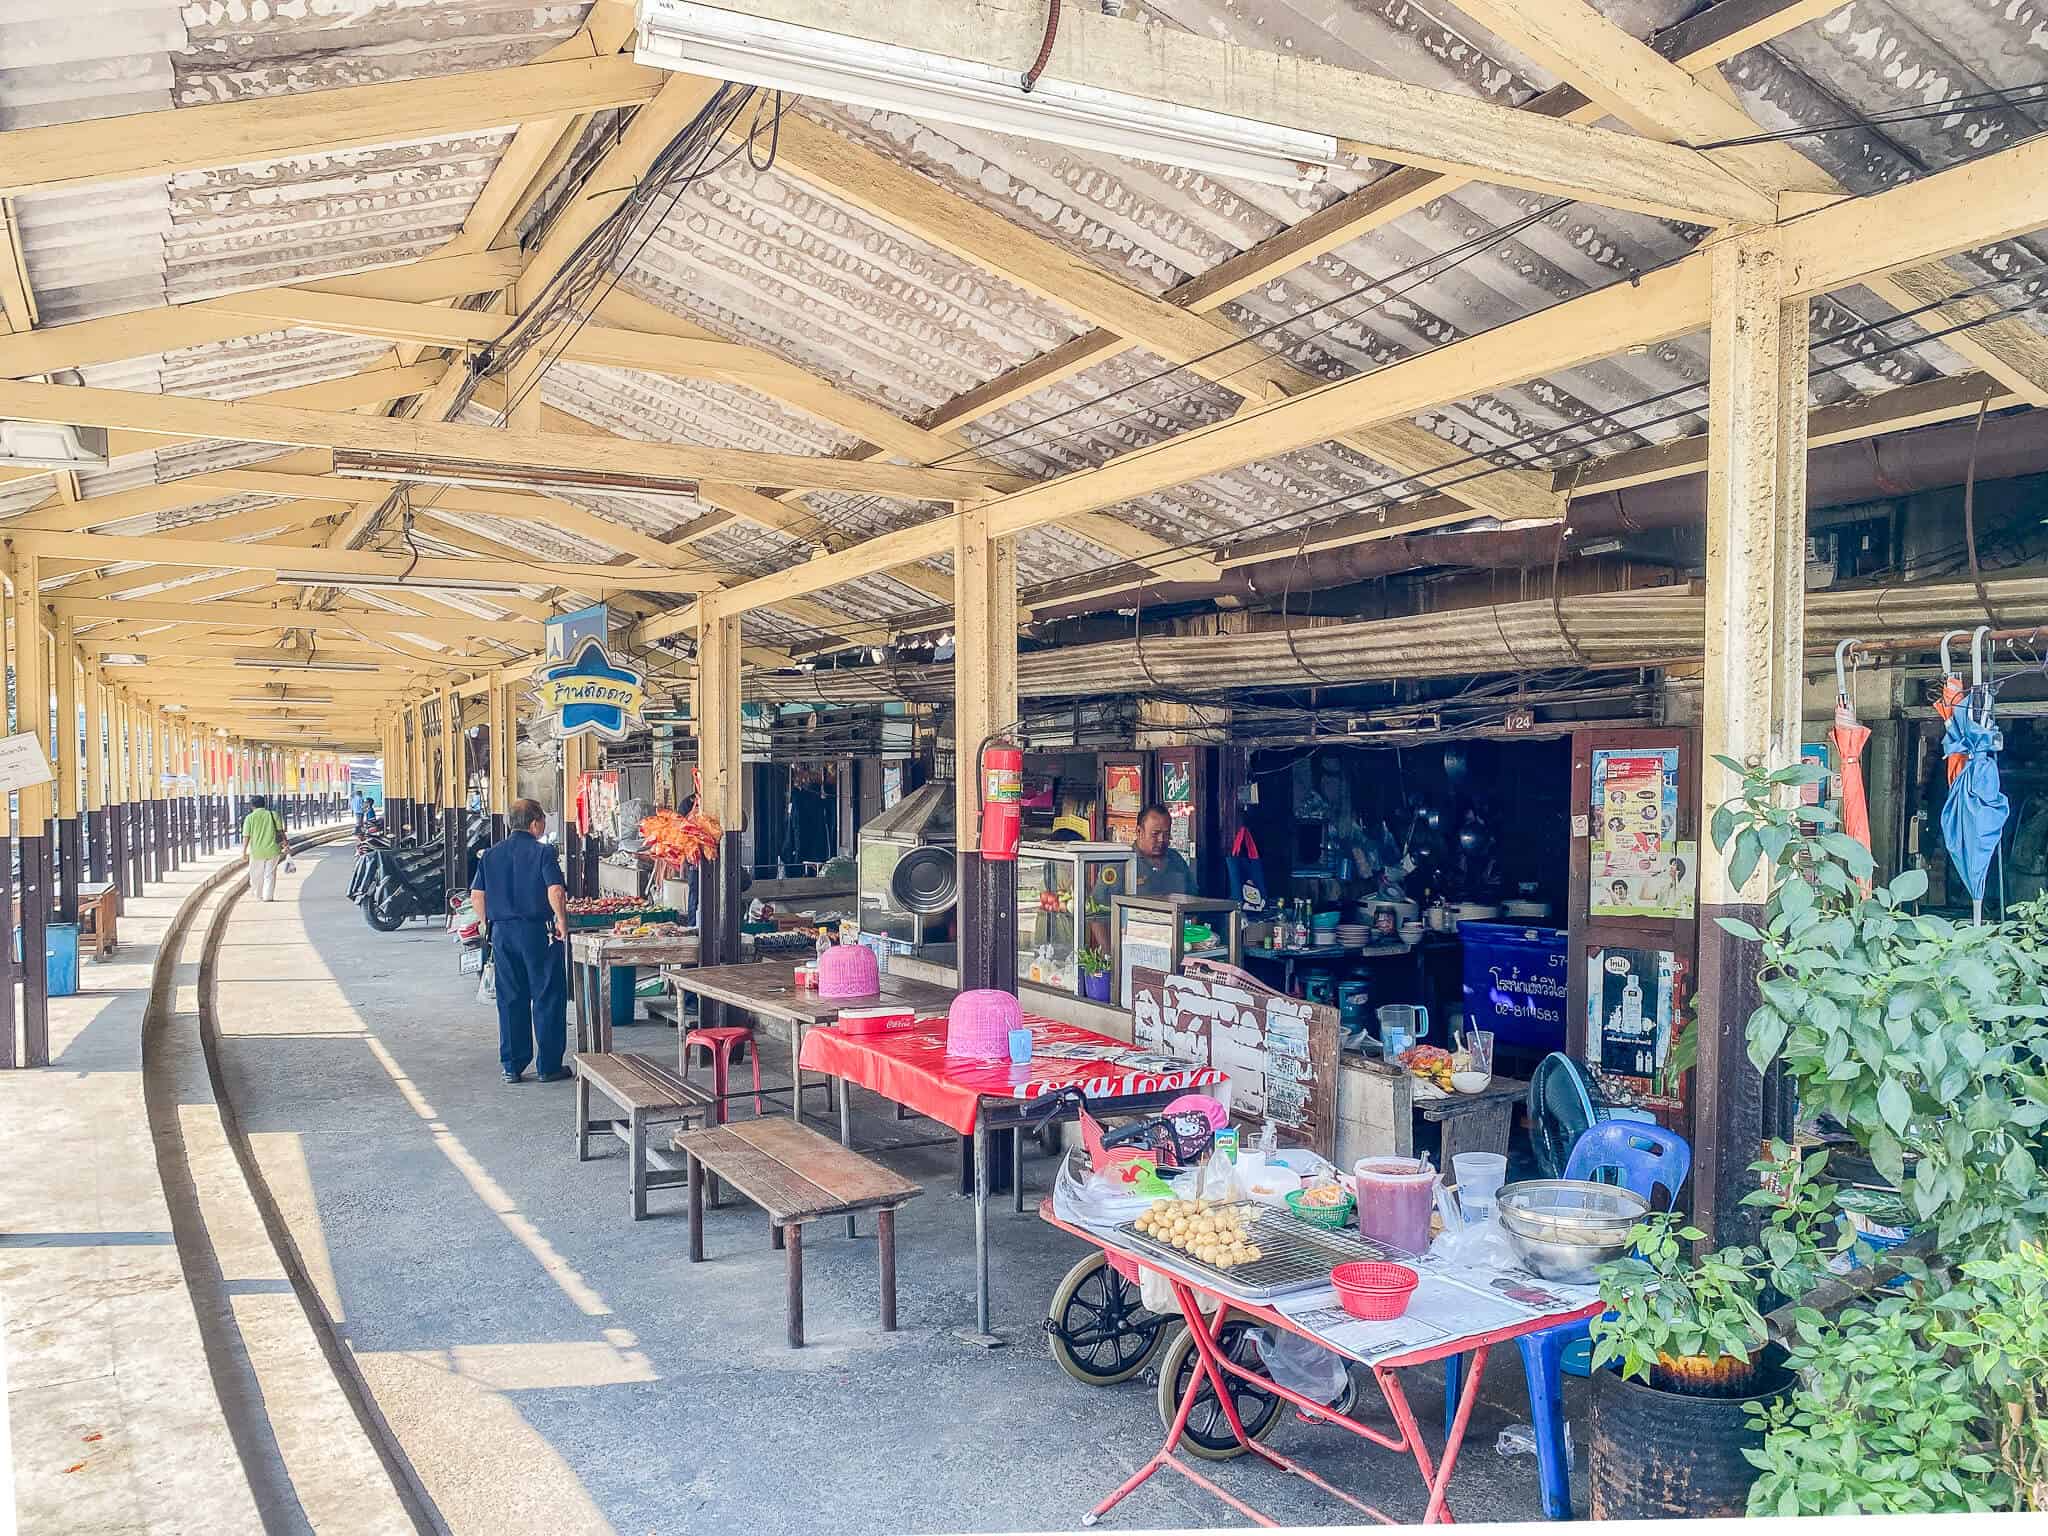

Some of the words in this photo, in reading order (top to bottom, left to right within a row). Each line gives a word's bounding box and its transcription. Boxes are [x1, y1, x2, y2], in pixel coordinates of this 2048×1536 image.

[554, 681, 633, 704] ร้านติดดาว
[1507, 716, 1531, 729] 1/24
